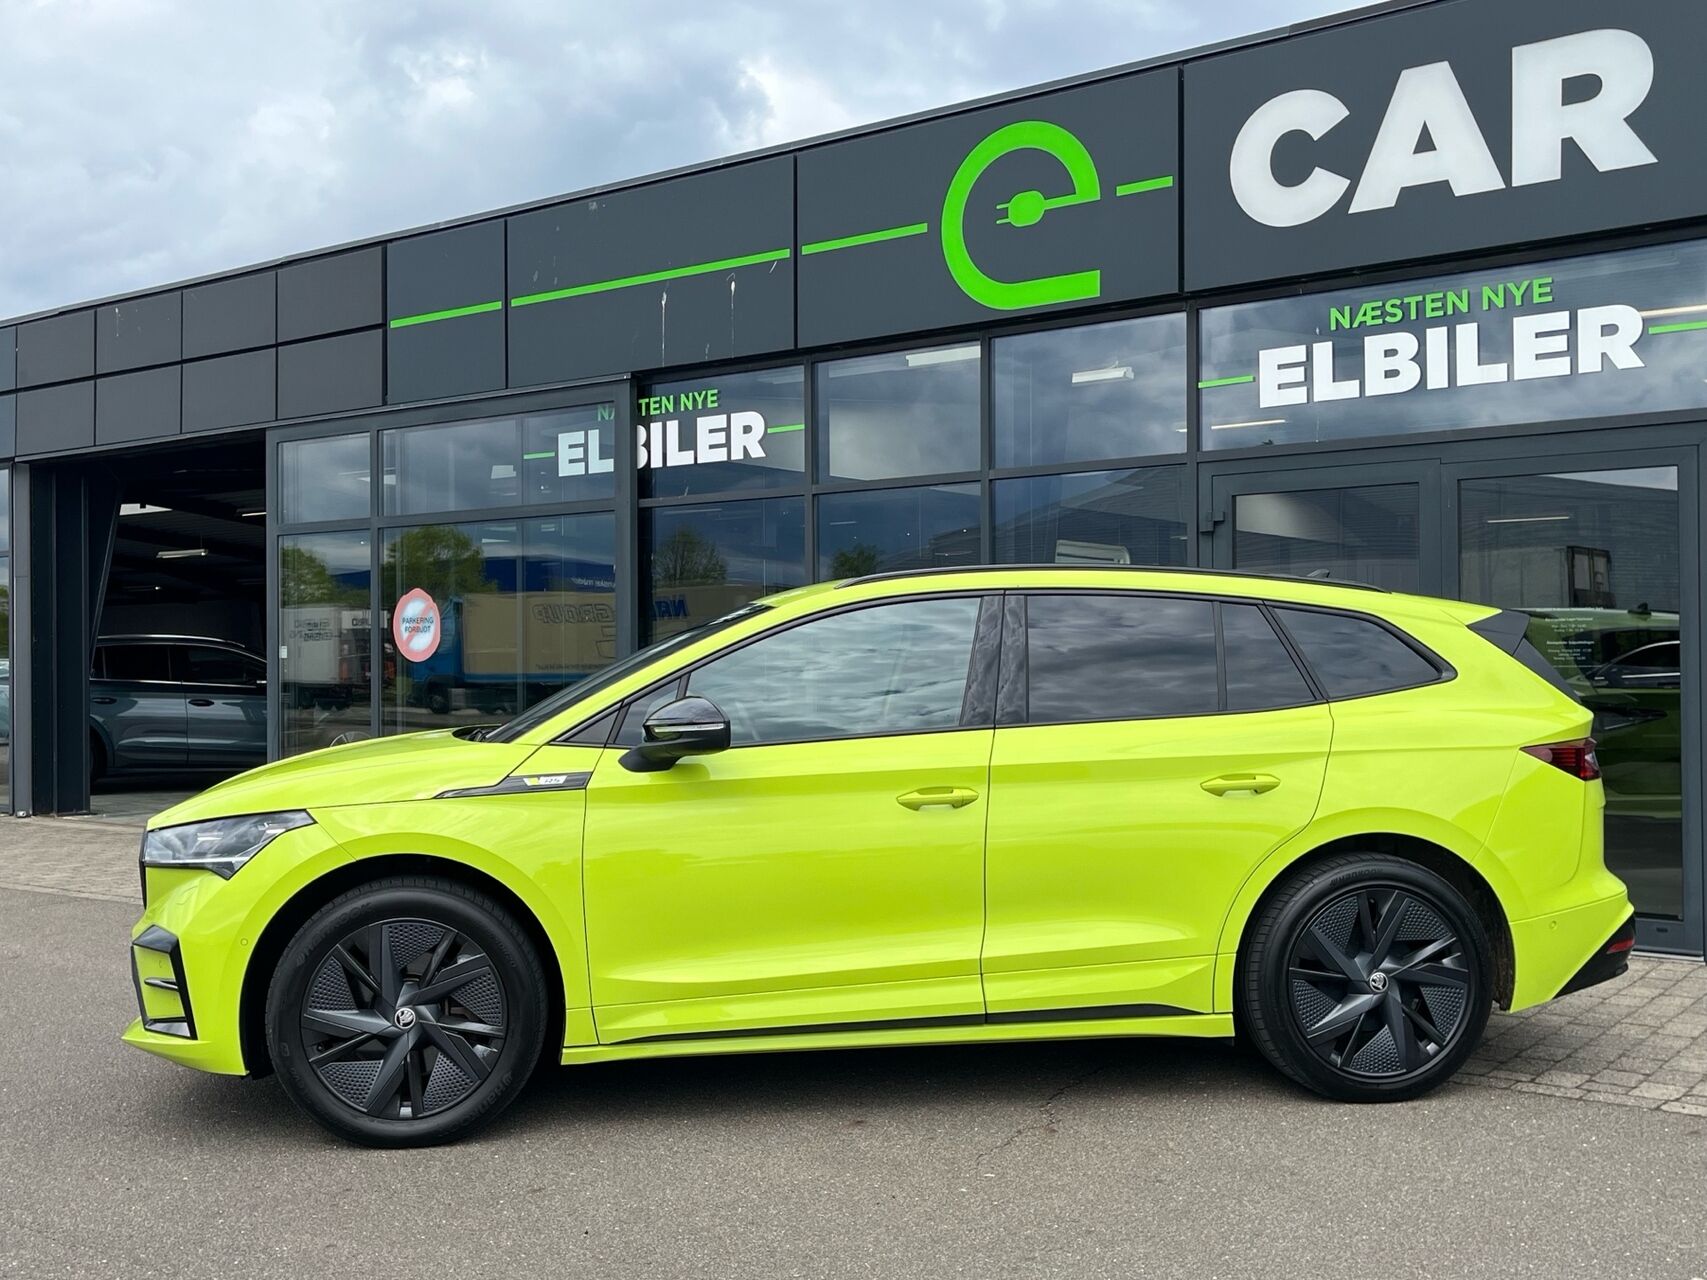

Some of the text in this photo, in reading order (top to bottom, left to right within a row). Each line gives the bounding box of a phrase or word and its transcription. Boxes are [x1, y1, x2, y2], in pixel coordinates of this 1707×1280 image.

[1229, 28, 1659, 227] CAR
[1329, 277, 1554, 331] NÆSTEN NYE
[1258, 303, 1646, 408] ELBILER
[597, 388, 719, 421] NTEN NYE
